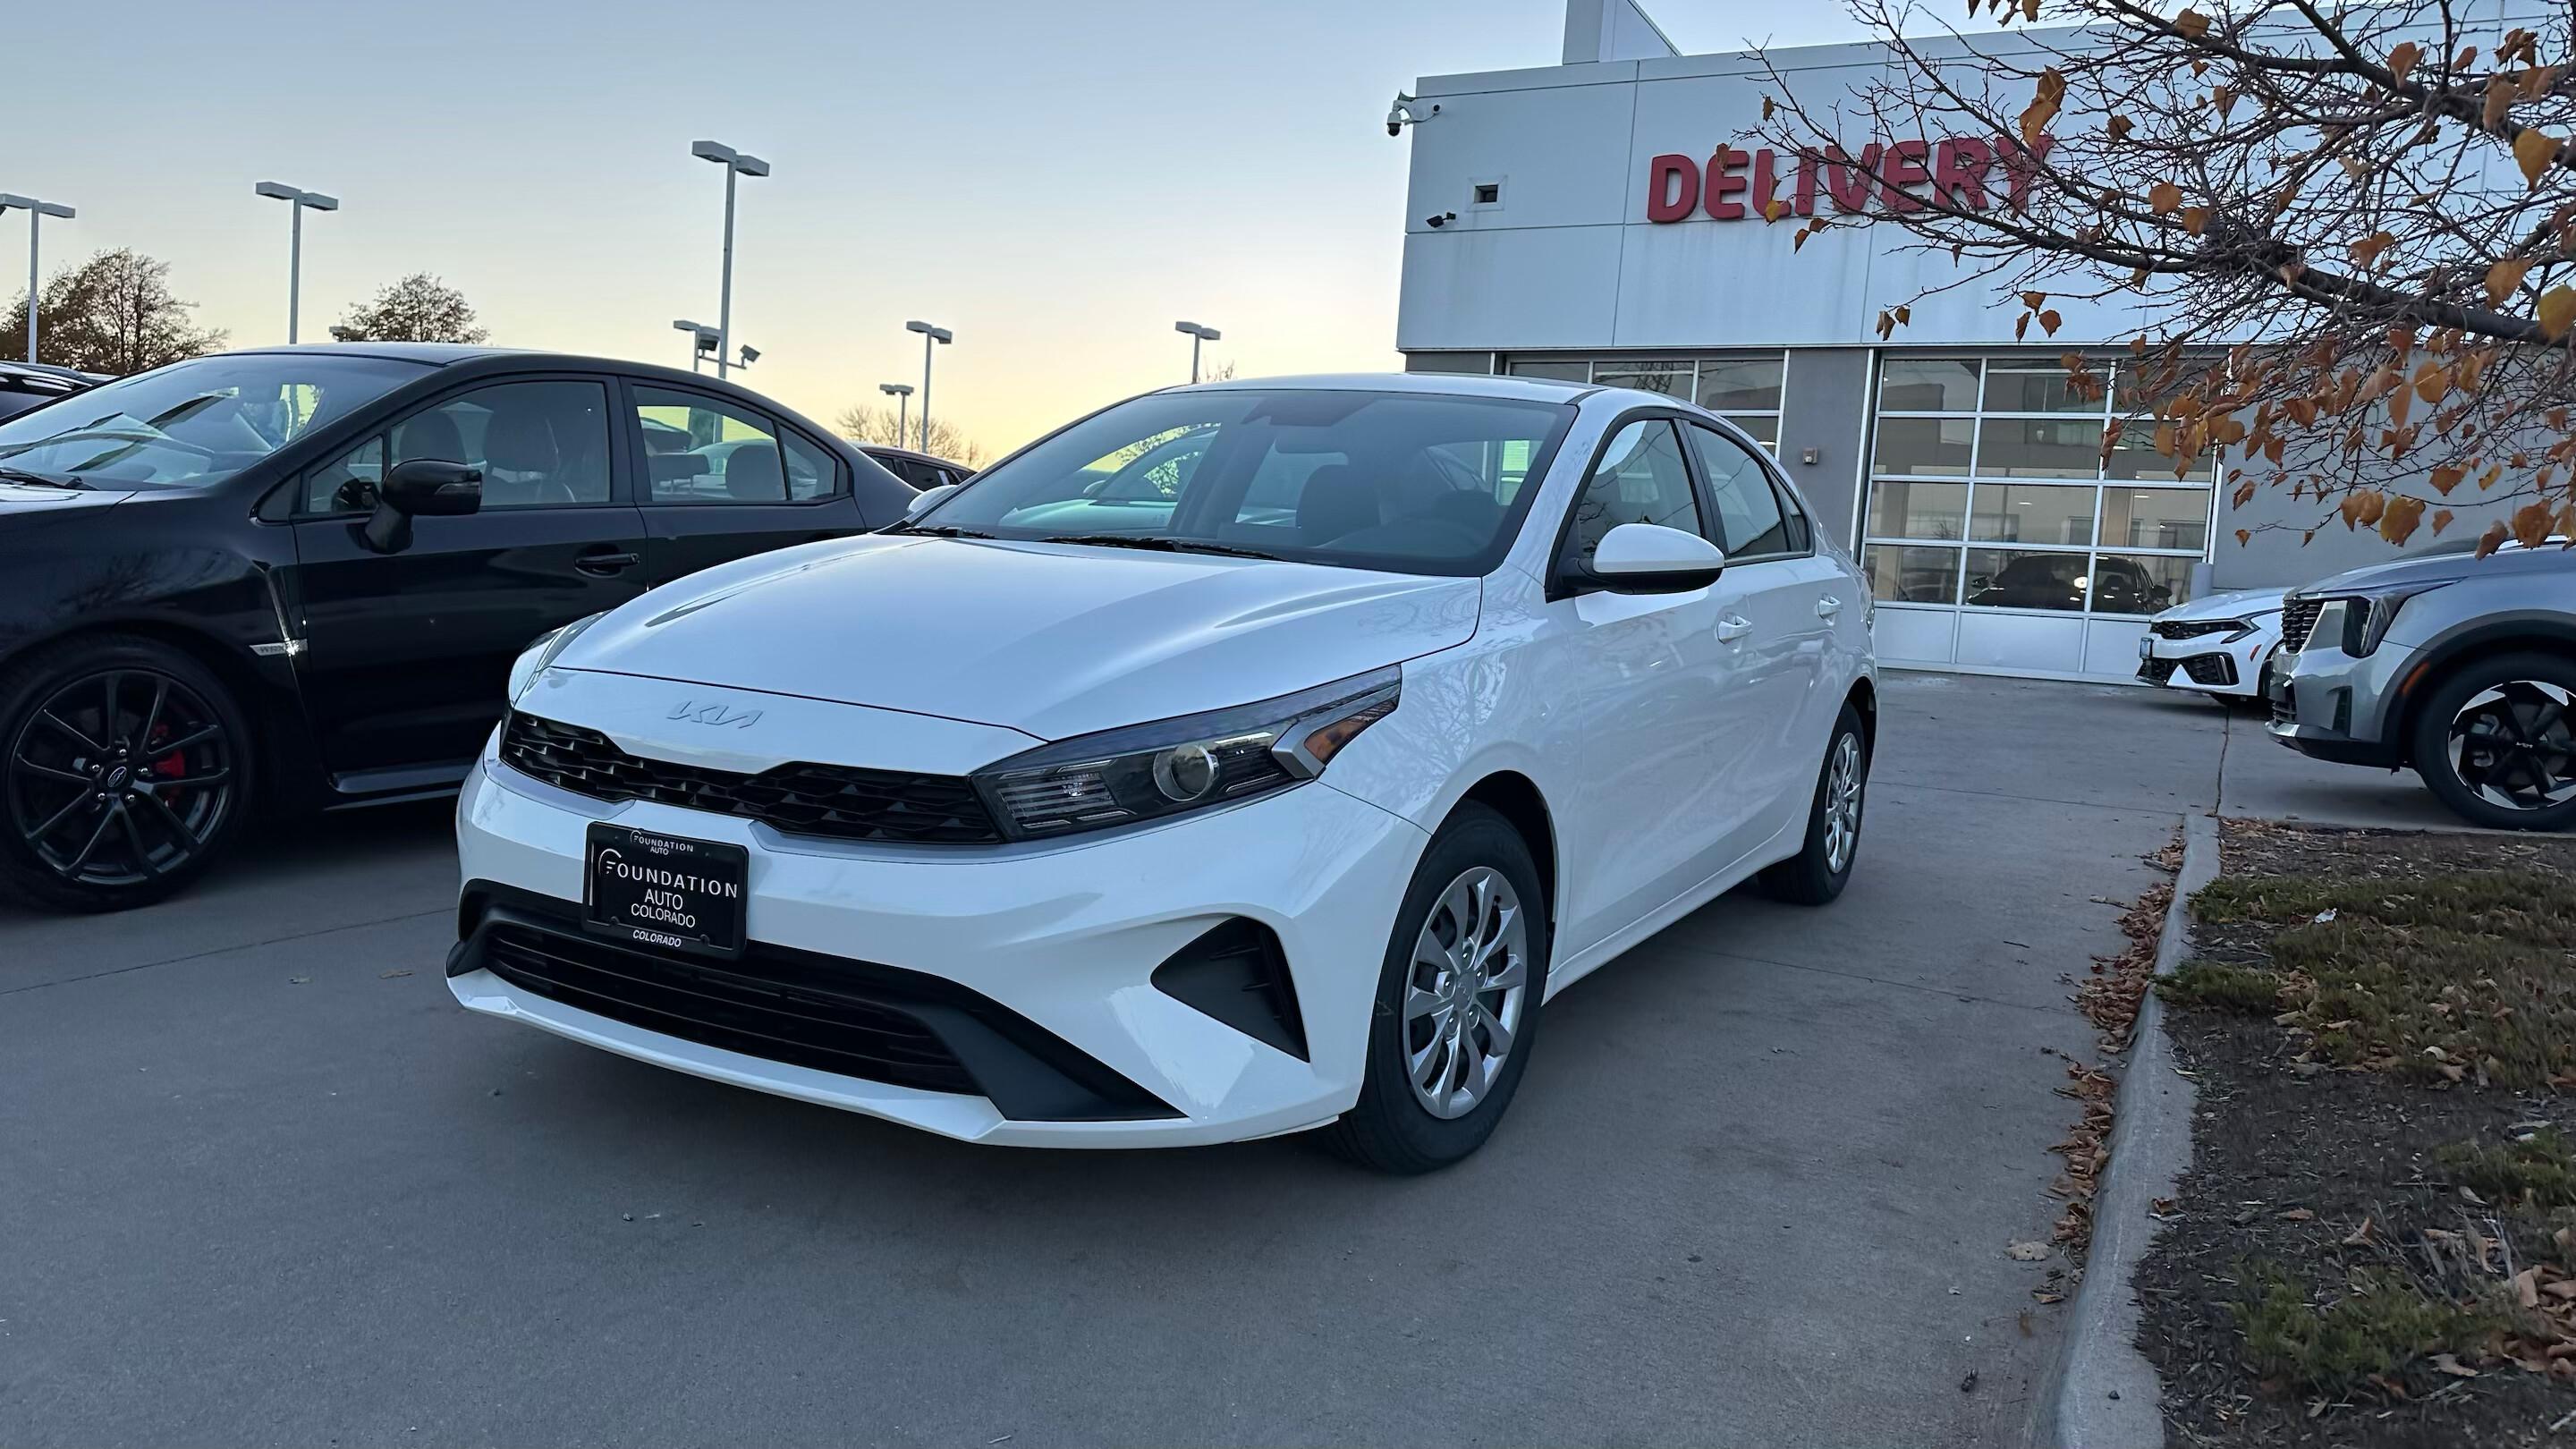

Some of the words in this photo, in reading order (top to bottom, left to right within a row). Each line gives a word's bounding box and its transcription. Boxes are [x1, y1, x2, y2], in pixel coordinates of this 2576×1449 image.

[1647, 134, 2055, 224] DELIVERY
[630, 830, 694, 852] FOUNDATION
[649, 845, 669, 856] AUTO
[598, 848, 738, 898] FOUNDATION
[644, 888, 683, 911] AUTO
[631, 903, 696, 928] COLORADO
[632, 929, 682, 948] COLORADO
